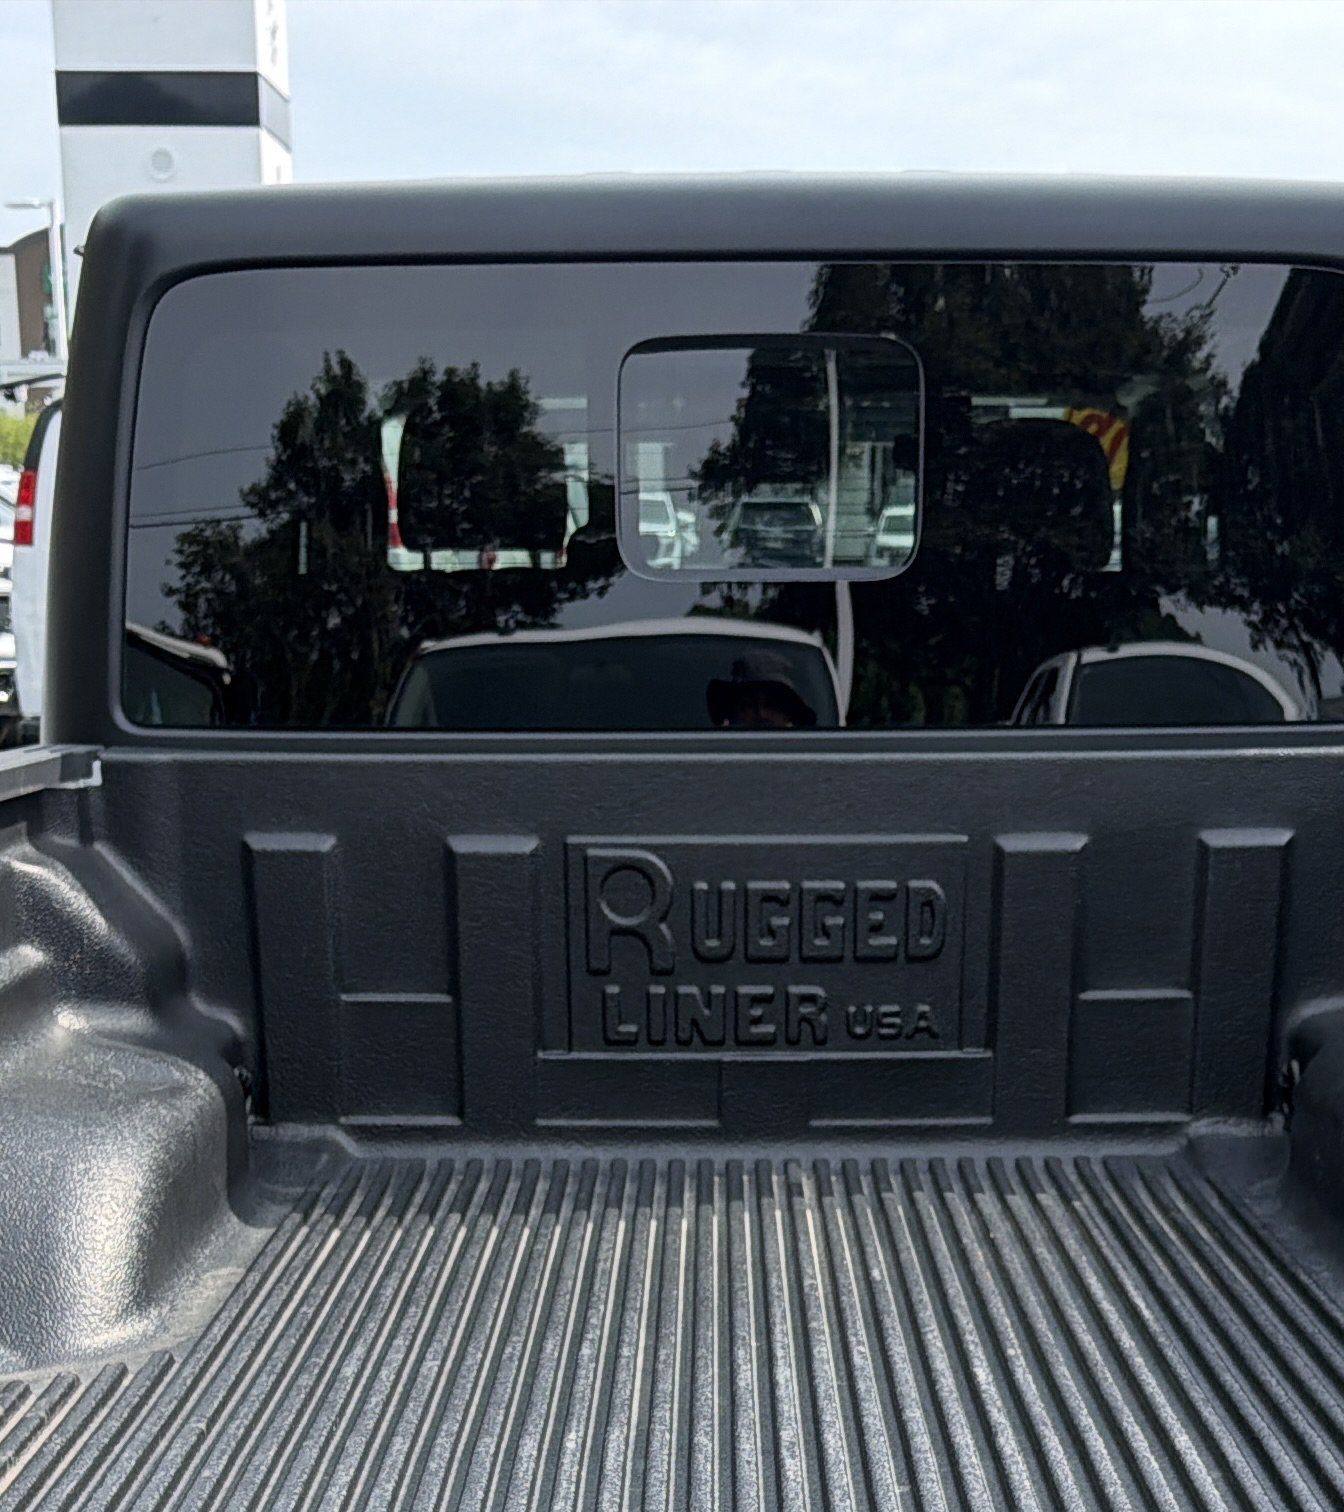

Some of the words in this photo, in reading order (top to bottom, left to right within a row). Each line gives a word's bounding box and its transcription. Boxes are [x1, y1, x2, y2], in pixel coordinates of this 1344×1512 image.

[583, 847, 949, 976] RUGGED
[600, 984, 829, 1048] LINER
[845, 1004, 940, 1041] USA
